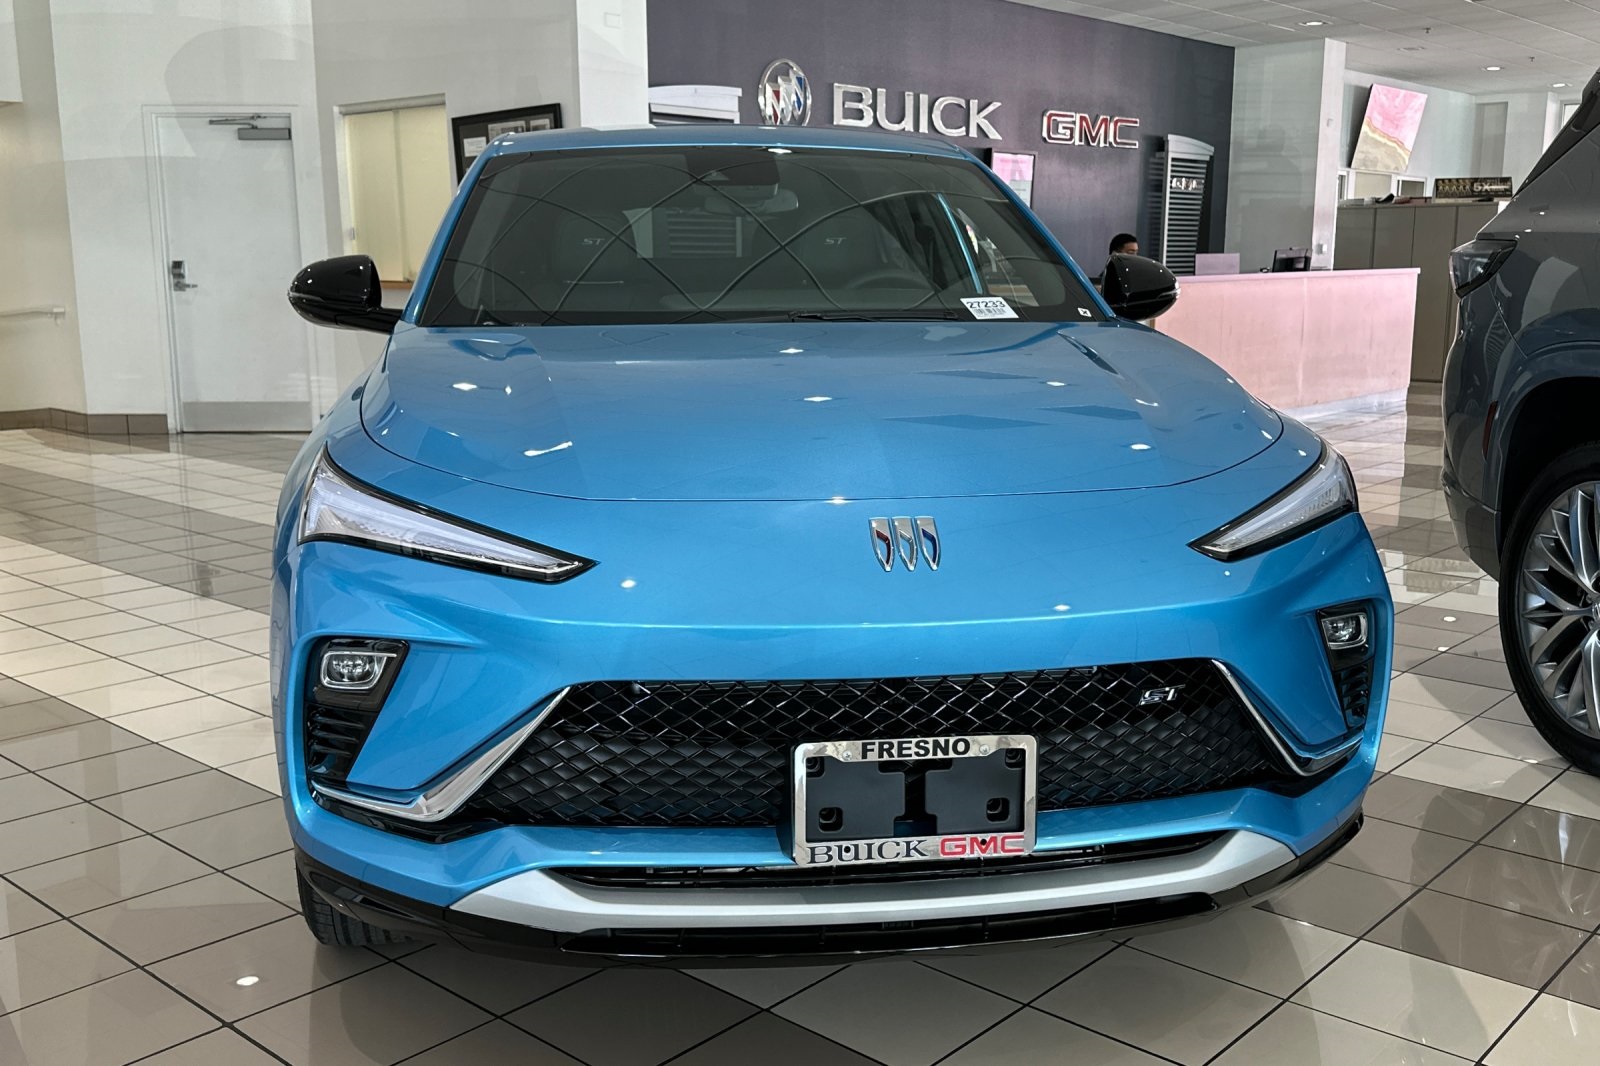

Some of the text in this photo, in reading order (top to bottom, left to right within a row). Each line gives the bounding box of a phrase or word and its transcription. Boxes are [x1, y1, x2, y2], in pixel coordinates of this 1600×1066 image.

[833, 82, 1002, 140] BUICK
[1042, 110, 1139, 149] GMC
[966, 300, 1006, 309] 27233
[861, 738, 971, 760] FRESNO
[807, 834, 1025, 865] BUICK GMC
